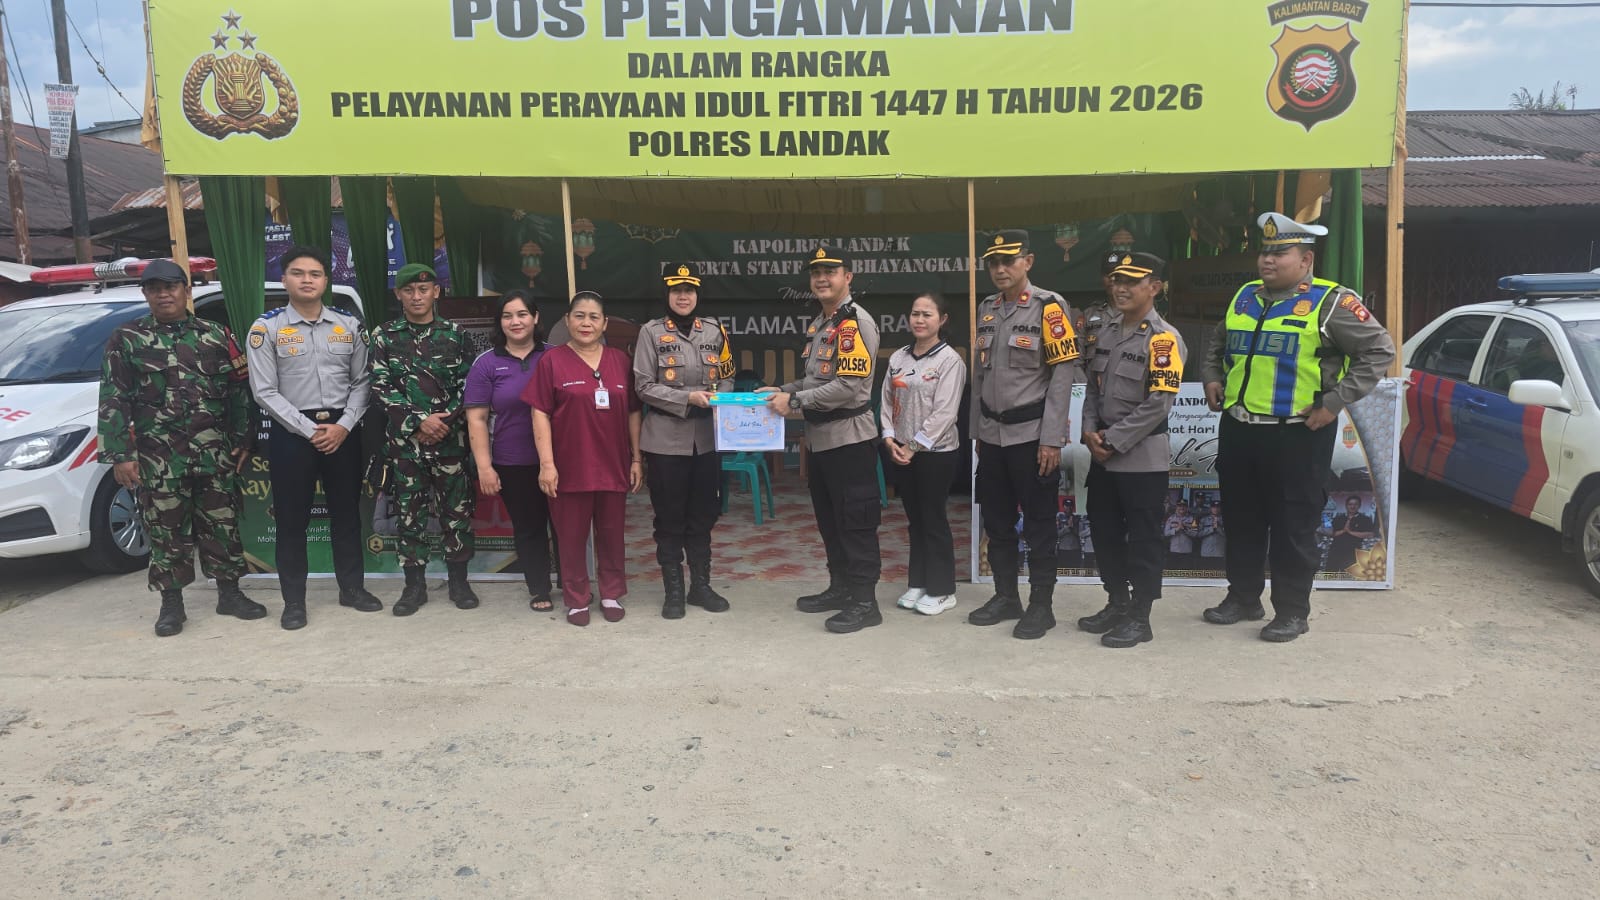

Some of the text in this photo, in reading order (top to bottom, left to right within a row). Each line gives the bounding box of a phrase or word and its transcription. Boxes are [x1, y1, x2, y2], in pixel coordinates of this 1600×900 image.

[452, 0, 1072, 38] POS PENGAMANAN
[1273, 2, 1362, 20] KALIMANTAN BARAT
[628, 51, 890, 79] DALAM RANGKA
[331, 83, 1203, 118] PELAYANAN PERAYAAN IDUL FITRI 1447 H TAHUN 2026
[628, 129, 890, 157] POLRES LANDAK
[733, 236, 911, 254] KAPOLRES LANDAK
[746, 260, 803, 275] STAFF
[717, 315, 812, 335] ELAMAT
[1012, 325, 1041, 334] POLRI
[659, 344, 681, 353] DEVI
[1121, 352, 1146, 363] POLRI
[837, 357, 867, 372] POLSEK
[1173, 397, 1208, 407] ANDO
[1188, 425, 1216, 434] Hari
[241, 479, 272, 500] ay
